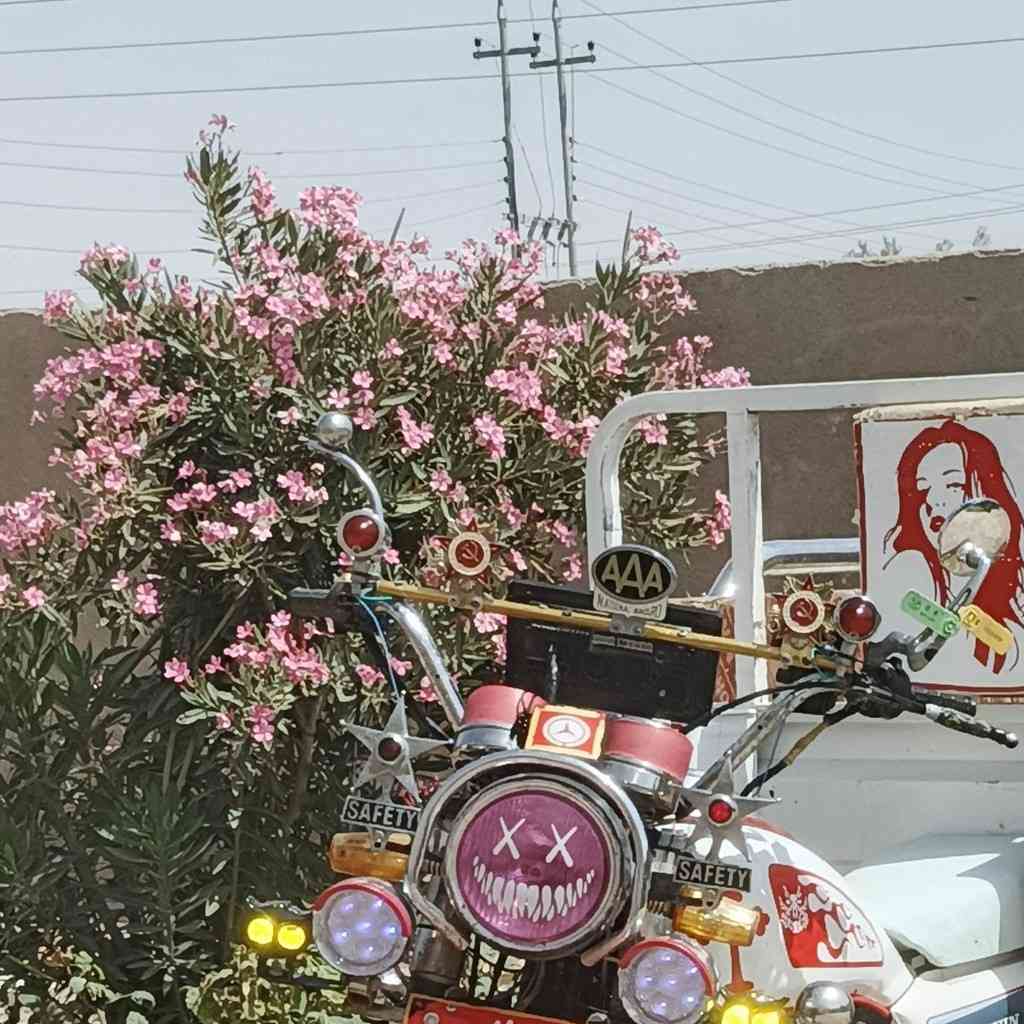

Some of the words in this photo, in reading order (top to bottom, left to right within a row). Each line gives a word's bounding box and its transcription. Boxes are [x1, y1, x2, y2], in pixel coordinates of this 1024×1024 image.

[601, 553, 664, 598] AAA
[347, 801, 417, 829] SAFETY
[679, 861, 747, 888] SAFETY
